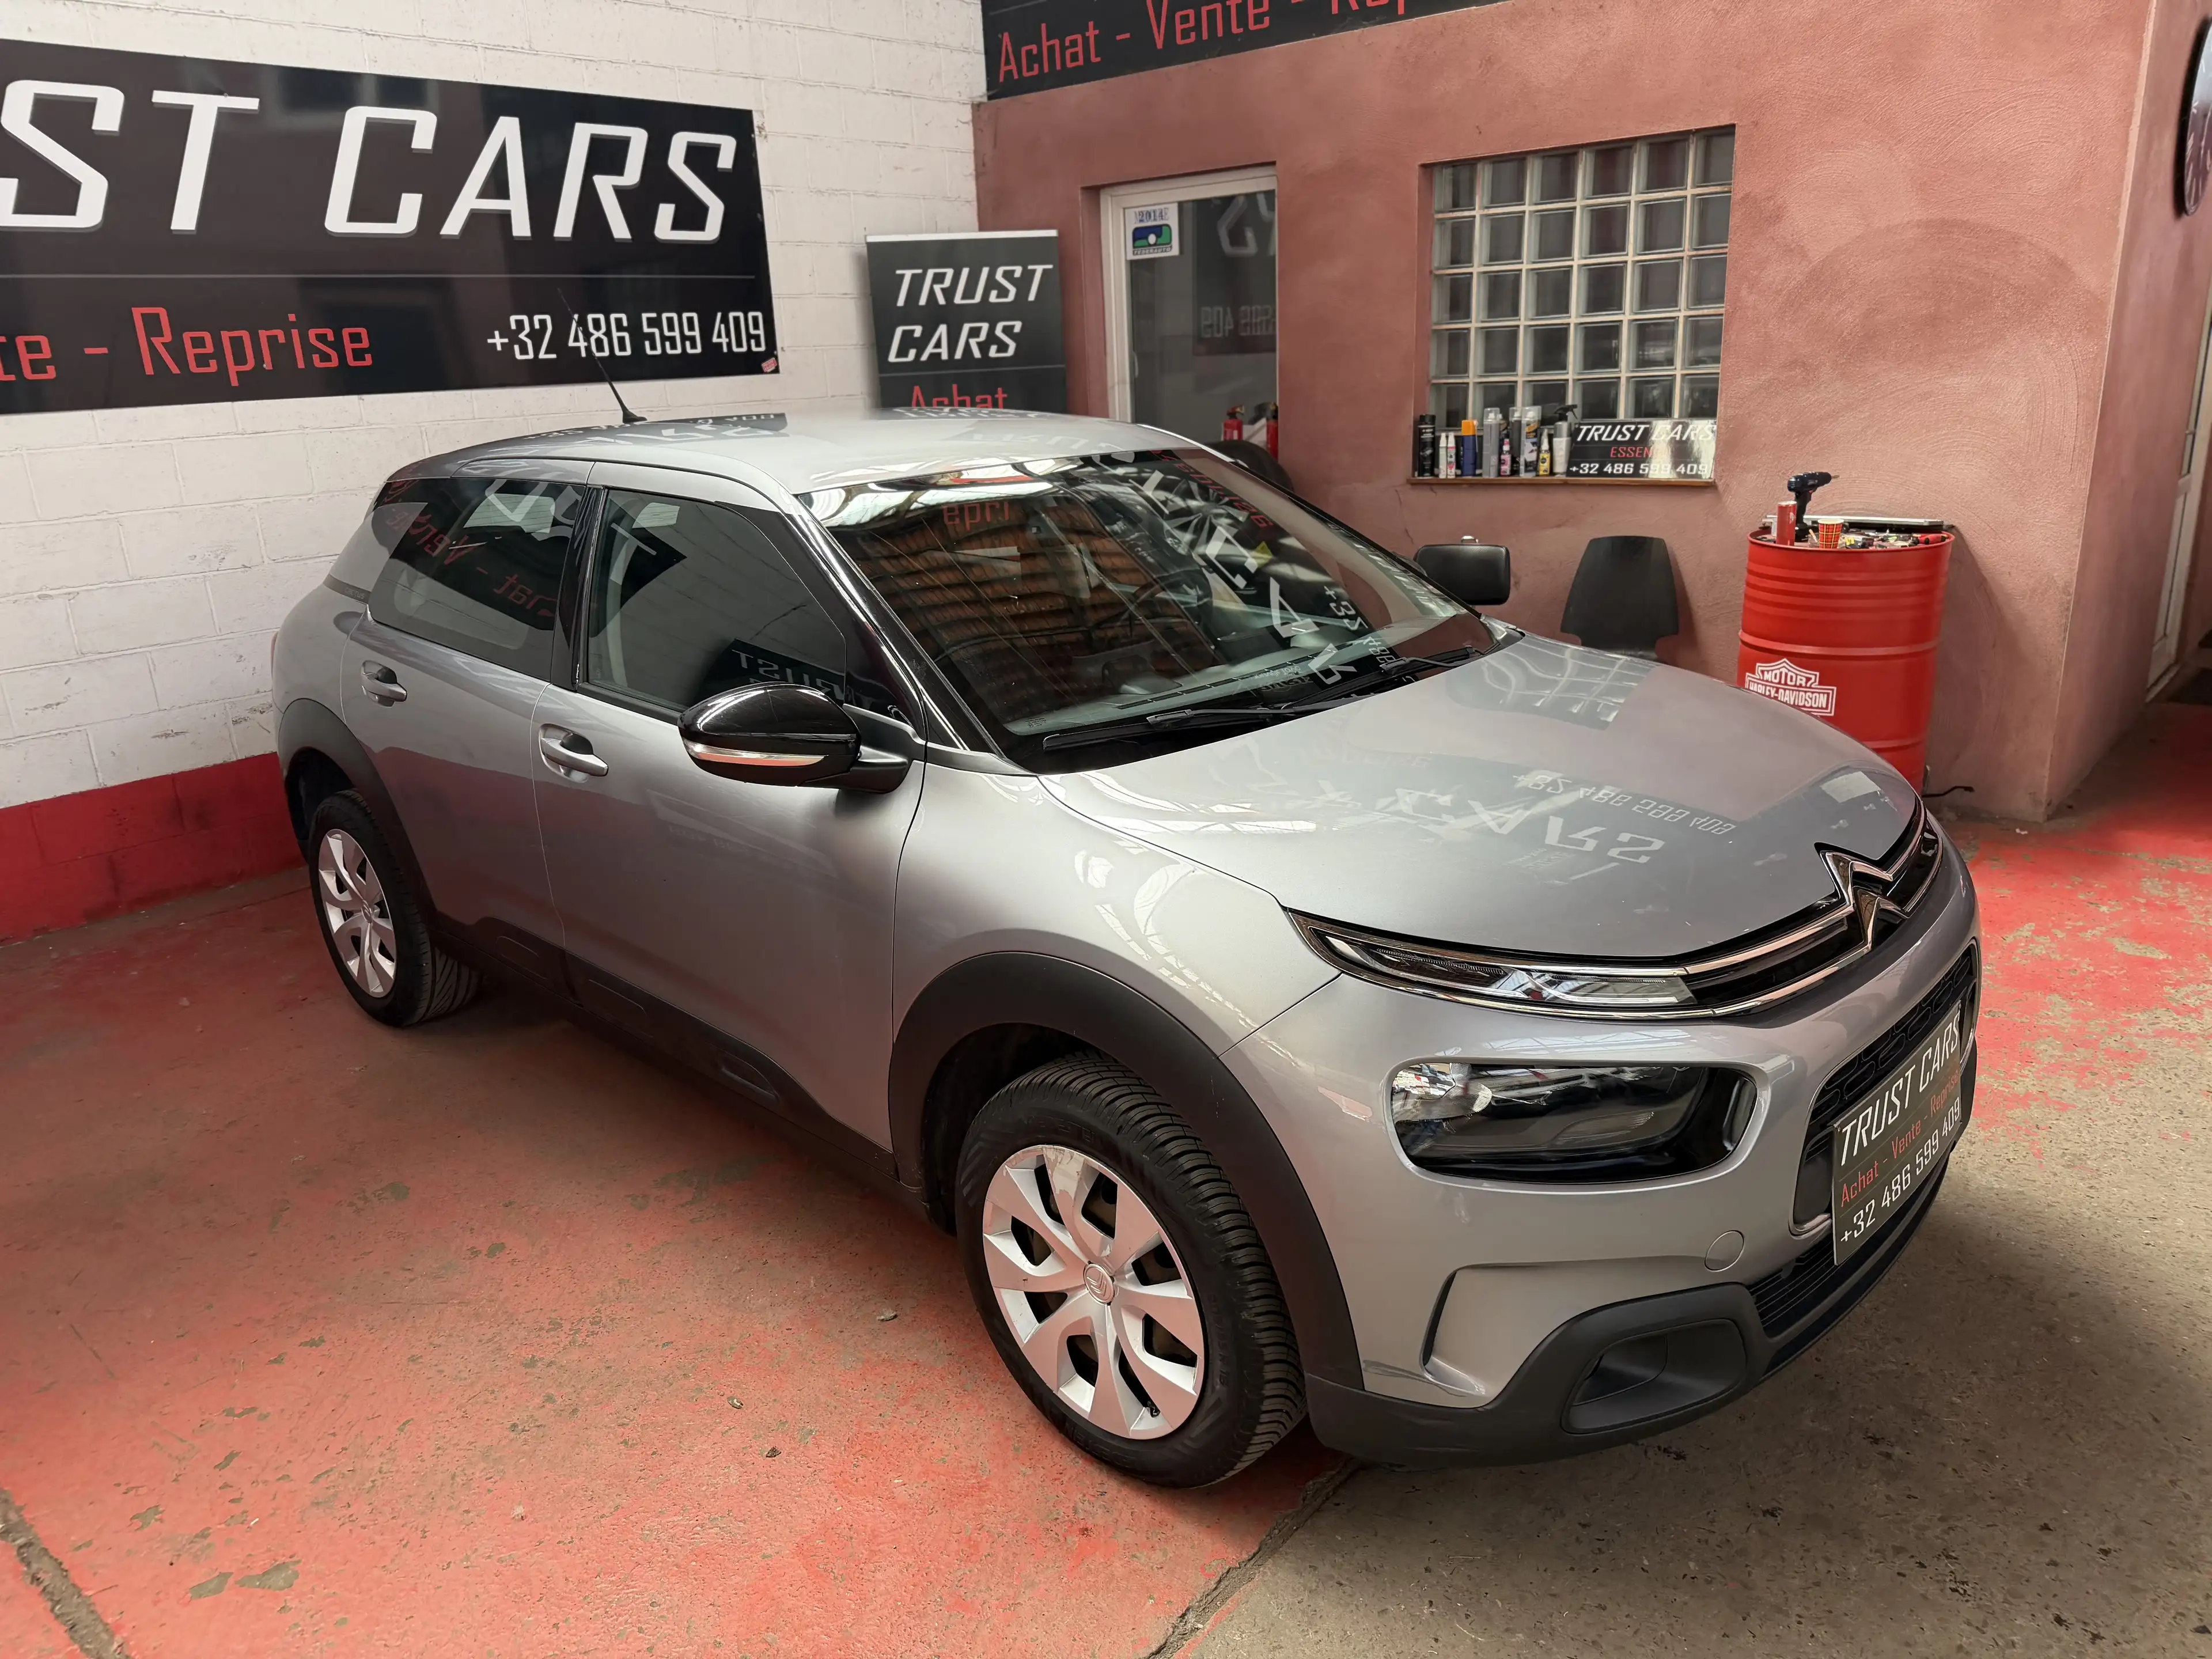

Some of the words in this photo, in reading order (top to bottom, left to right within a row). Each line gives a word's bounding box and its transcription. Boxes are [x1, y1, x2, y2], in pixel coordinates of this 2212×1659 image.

[999, 21, 1101, 82] Achat
[1145, 0, 1270, 50] Vente
[324, 106, 737, 242] CARS
[895, 264, 1054, 306] TRUST
[131, 307, 373, 387] Reprise
[487, 314, 557, 360] +32
[567, 312, 632, 358] 486
[642, 312, 702, 355] 599
[712, 311, 766, 353] 409
[888, 320, 1022, 363] CARS
[1577, 425, 1650, 441] TRUST
[1651, 423, 1717, 441] CARS
[1610, 446, 1656, 459] ESSEN
[1569, 463, 1600, 475] +32
[1603, 463, 1635, 475] 486
[1763, 667, 1806, 687] MOTOR
[1840, 1065, 1916, 1166] TRUST
[1919, 1011, 1960, 1093] CARS
[1840, 1160, 1879, 1207] Achat
[1891, 1119, 1921, 1159] Vente
[1930, 1069, 1959, 1118] Reprise
[1840, 1199, 1875, 1243] +32
[1881, 1164, 1911, 1208] 486
[1916, 1130, 1940, 1176] 599
[1942, 1097, 1960, 1137] 409
